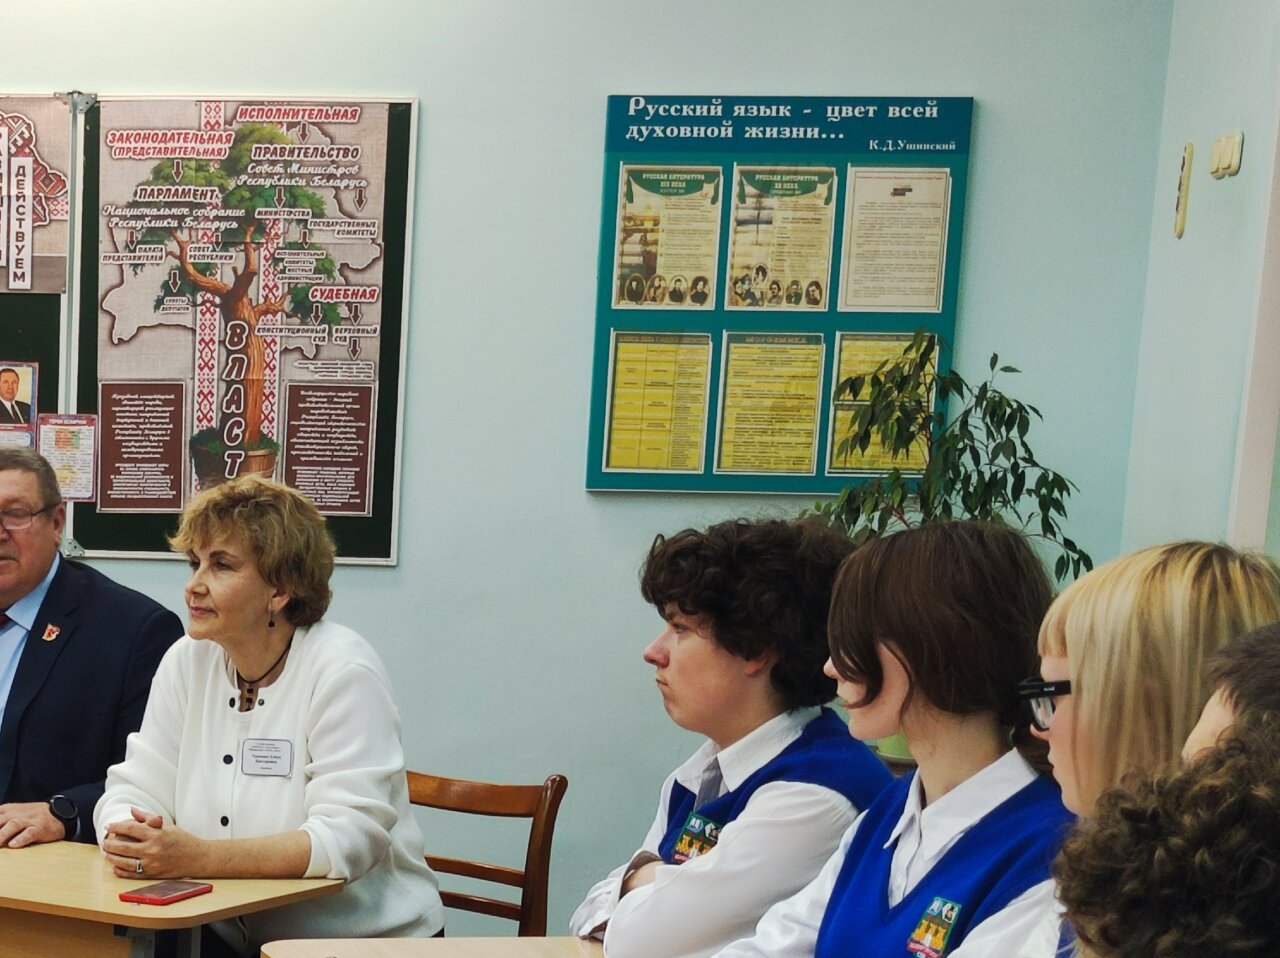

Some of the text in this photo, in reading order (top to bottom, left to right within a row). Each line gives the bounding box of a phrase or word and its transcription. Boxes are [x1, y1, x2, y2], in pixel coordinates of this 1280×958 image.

[239, 107, 359, 121] ИСПОЛНИТЕЛЬНАЯ
[628, 96, 723, 120] Русский
[732, 104, 792, 117] язык
[826, 105, 878, 122] цвет
[887, 100, 939, 118] всей
[625, 119, 845, 142] духовной жизни...
[108, 132, 234, 145] ЗАКОНОДАТЕЛЬНАЯ
[113, 146, 228, 158] (ПРЕДСТАВИТЕЛЬНАЯ)
[252, 146, 360, 160] ПРАВИТЕЛЬСТВО
[247, 162, 360, 177] Совет Министров
[236, 174, 368, 189] Республики Беларусь
[138, 187, 218, 201] ПАРЛАМЕНТ
[102, 204, 246, 219] Национальное собрание
[12, 164, 28, 283] ДЕЙСТВУЕМ
[108, 217, 239, 232] Республики Беларусь
[308, 220, 377, 229] ГОСУДАРСТВЕННЫЕ
[310, 287, 377, 301] СУДЕБНАЯ
[256, 327, 328, 335] КОНСТИТУЦИОННЫЙ
[334, 327, 378, 335] ВЕРХОВНЫЙ
[222, 321, 249, 479] ВЛАСТ
